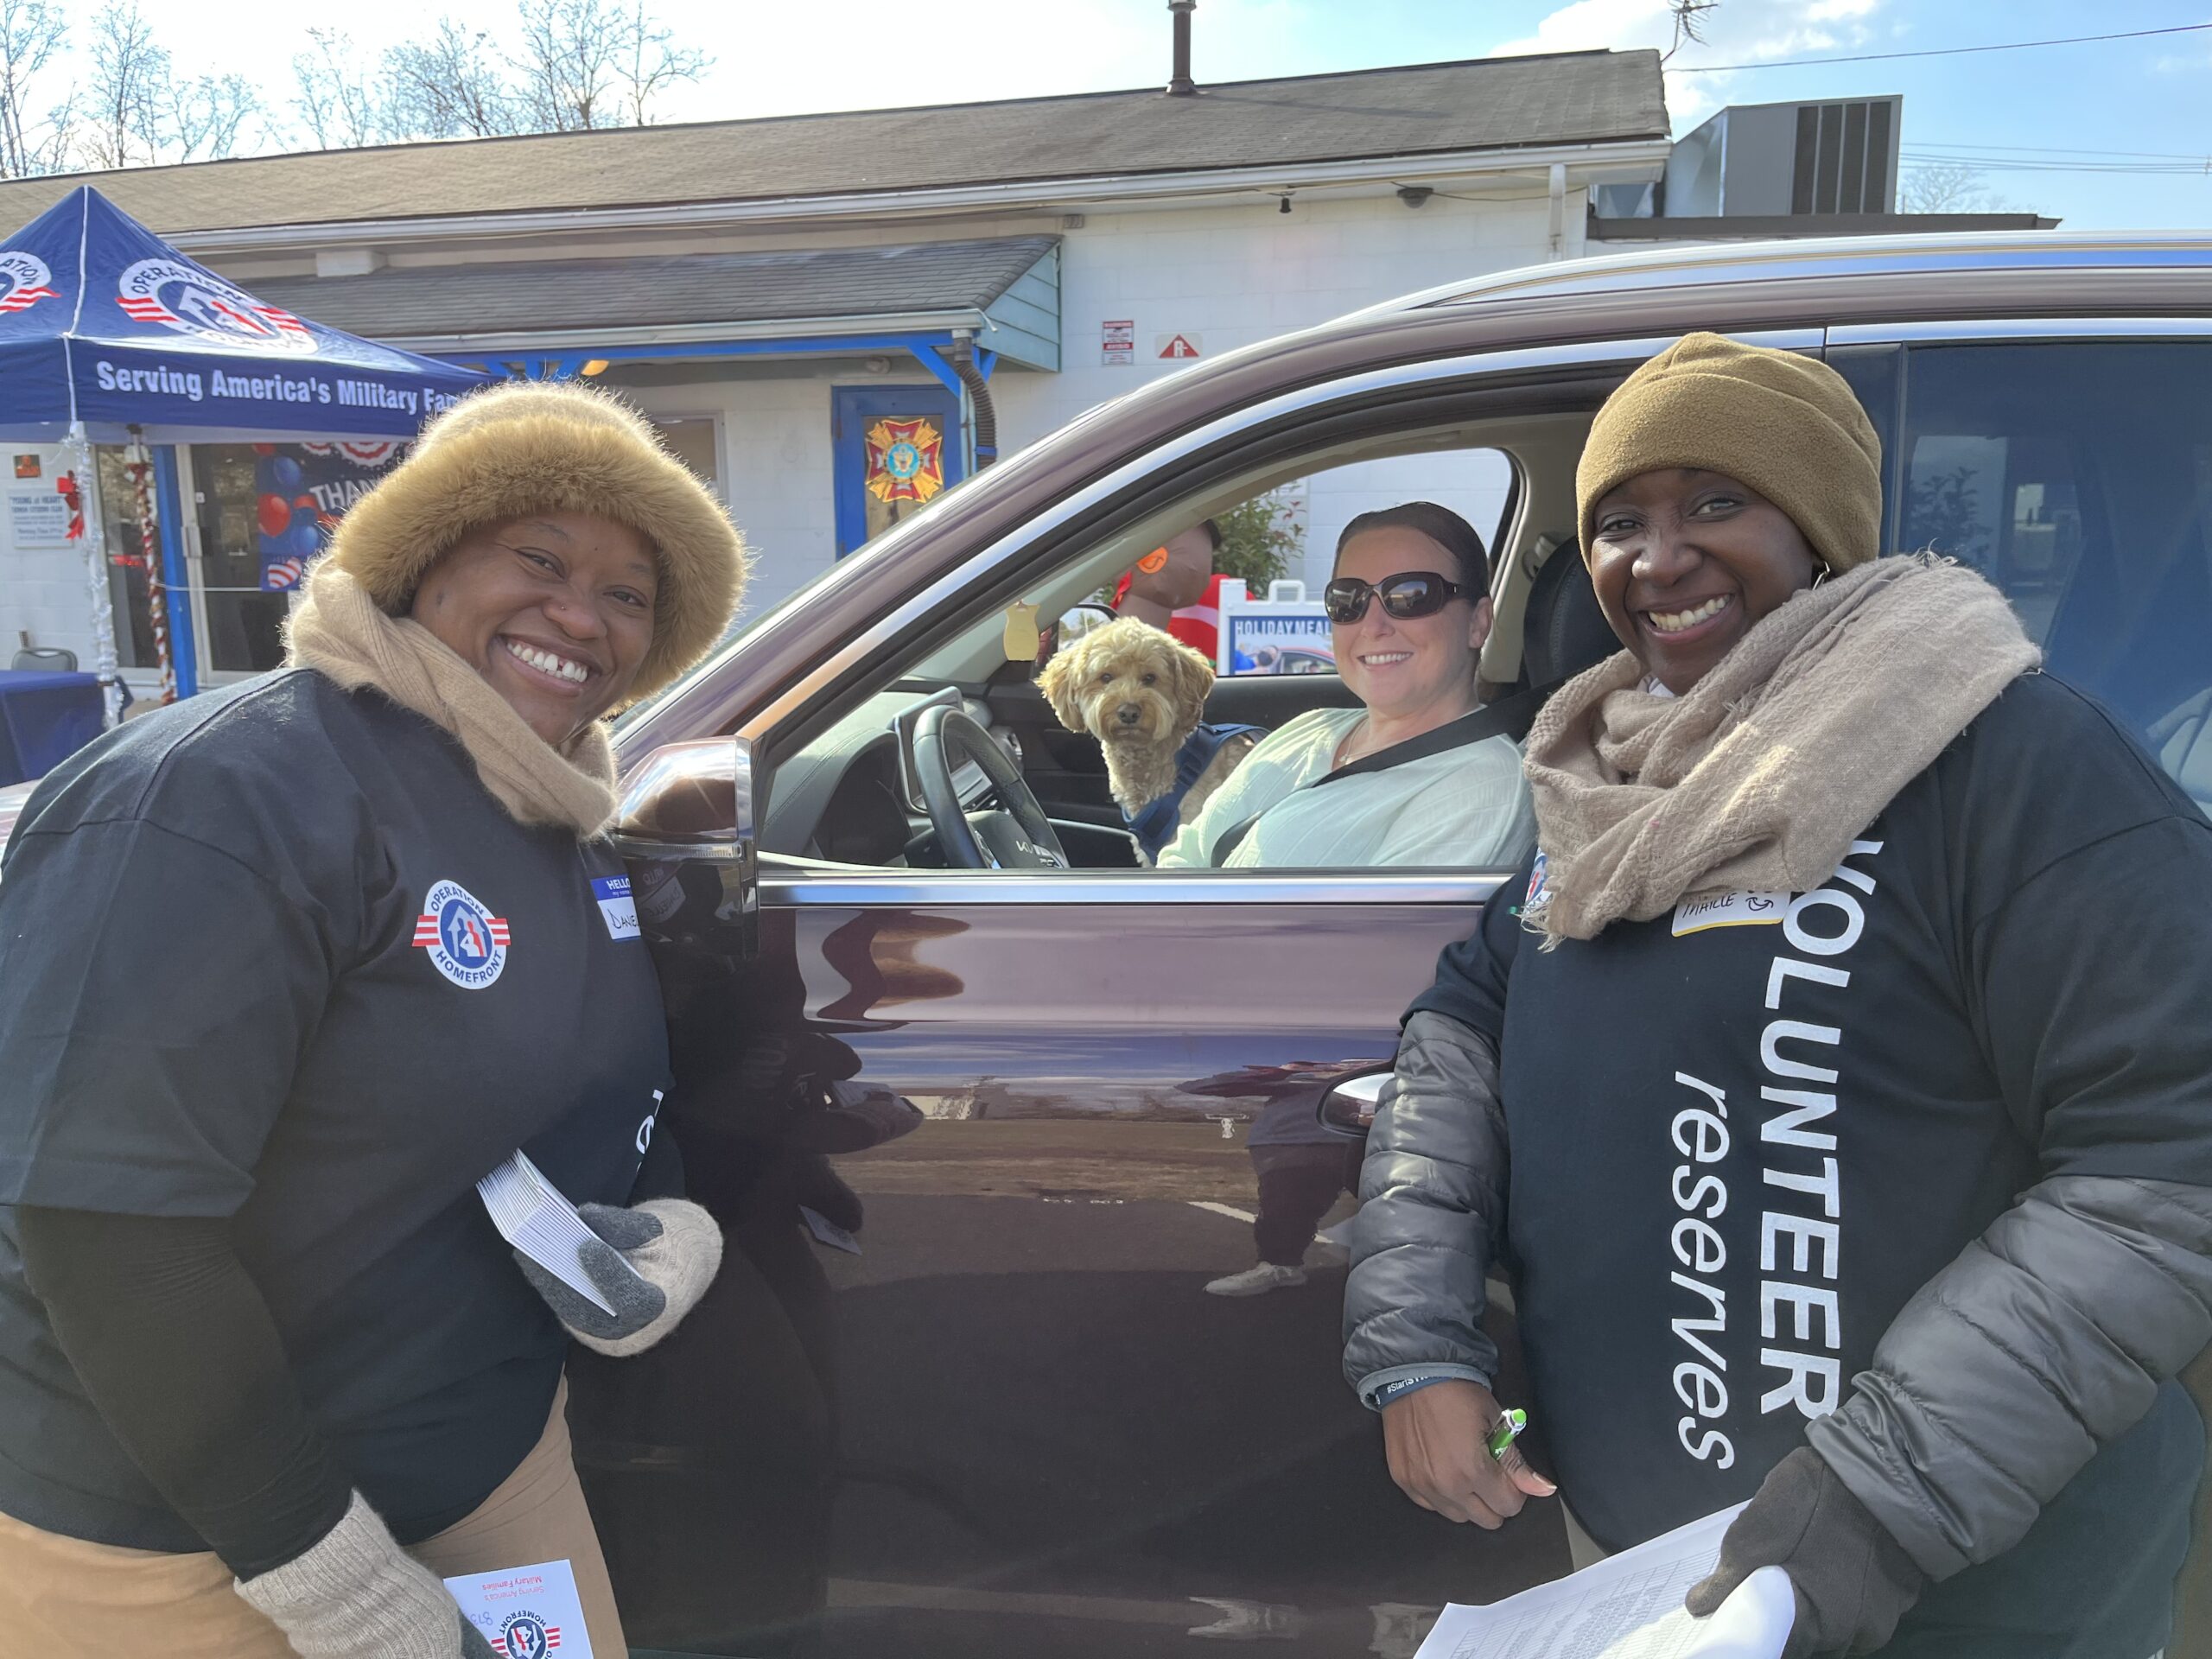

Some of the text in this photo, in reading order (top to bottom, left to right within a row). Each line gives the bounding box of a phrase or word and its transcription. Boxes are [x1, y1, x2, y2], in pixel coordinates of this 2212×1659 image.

[97, 360, 203, 401] Serving
[211, 370, 332, 404] America's
[337, 379, 418, 415] Military
[607, 878, 631, 890] HELLO
[431, 887, 484, 914] OPERATION
[607, 908, 639, 929] DANIE
[436, 950, 502, 983] HOMEFRONT
[1671, 1071, 1734, 1469] reserves
[483, 1576, 542, 1590] Military Families
[485, 1586, 543, 1601] Serving America's
[499, 1610, 547, 1635] HOMEFRONT
